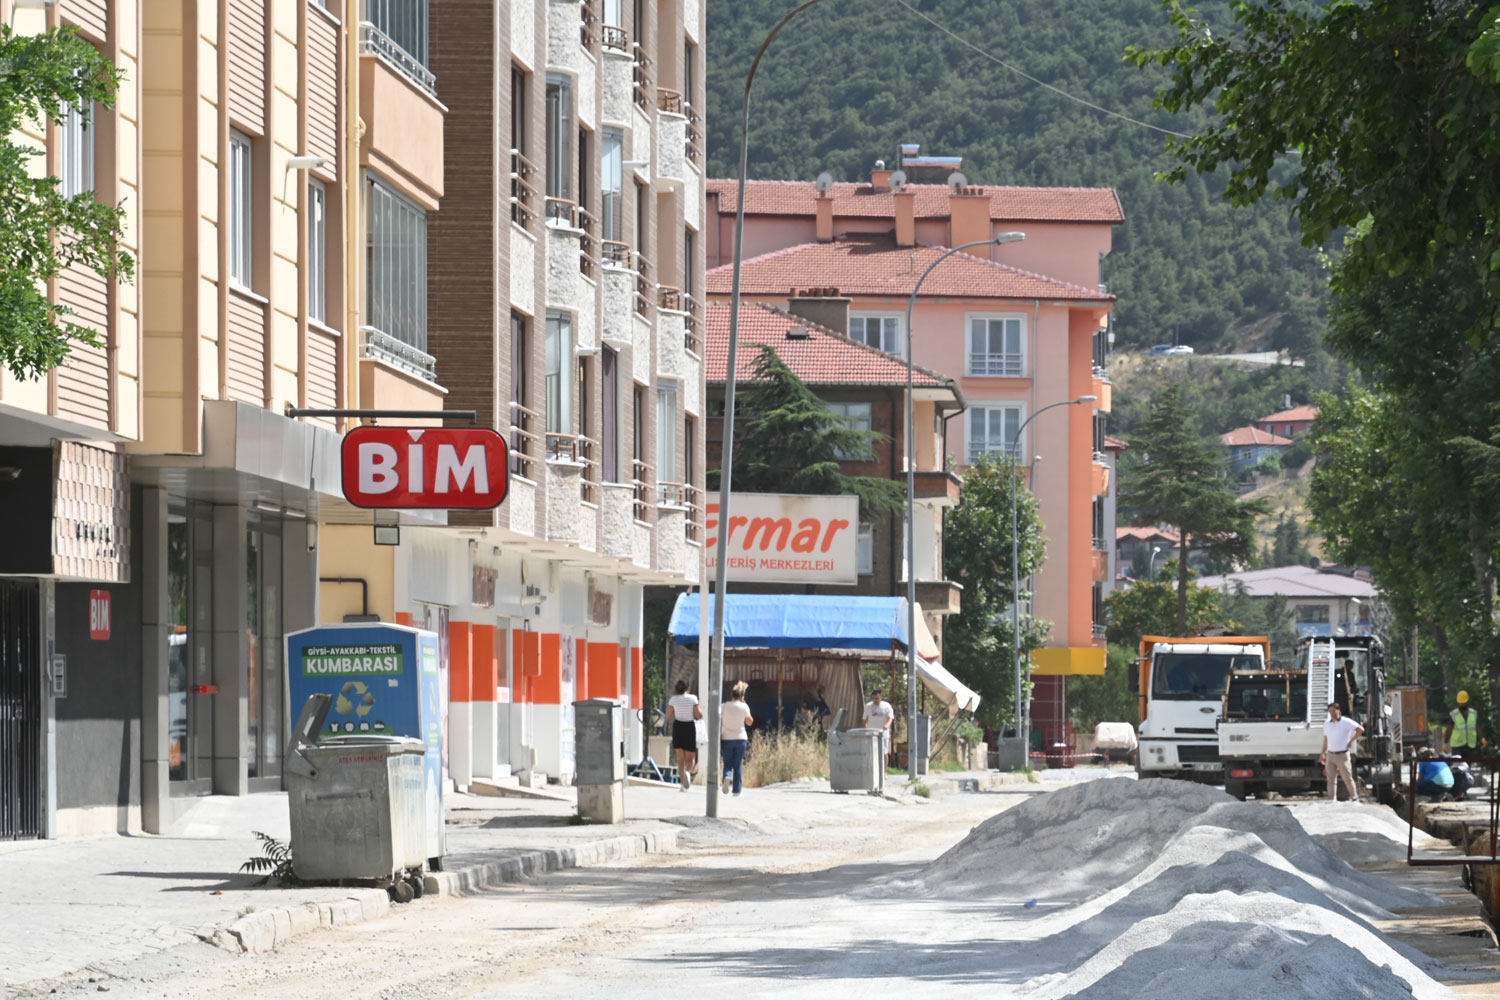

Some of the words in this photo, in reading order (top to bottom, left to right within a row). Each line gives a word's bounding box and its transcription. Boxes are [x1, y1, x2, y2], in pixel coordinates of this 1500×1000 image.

[358, 429, 490, 494] BİM
[760, 558, 834, 571] MERKEZLERİ
[306, 656, 398, 673] KUMBARASI
